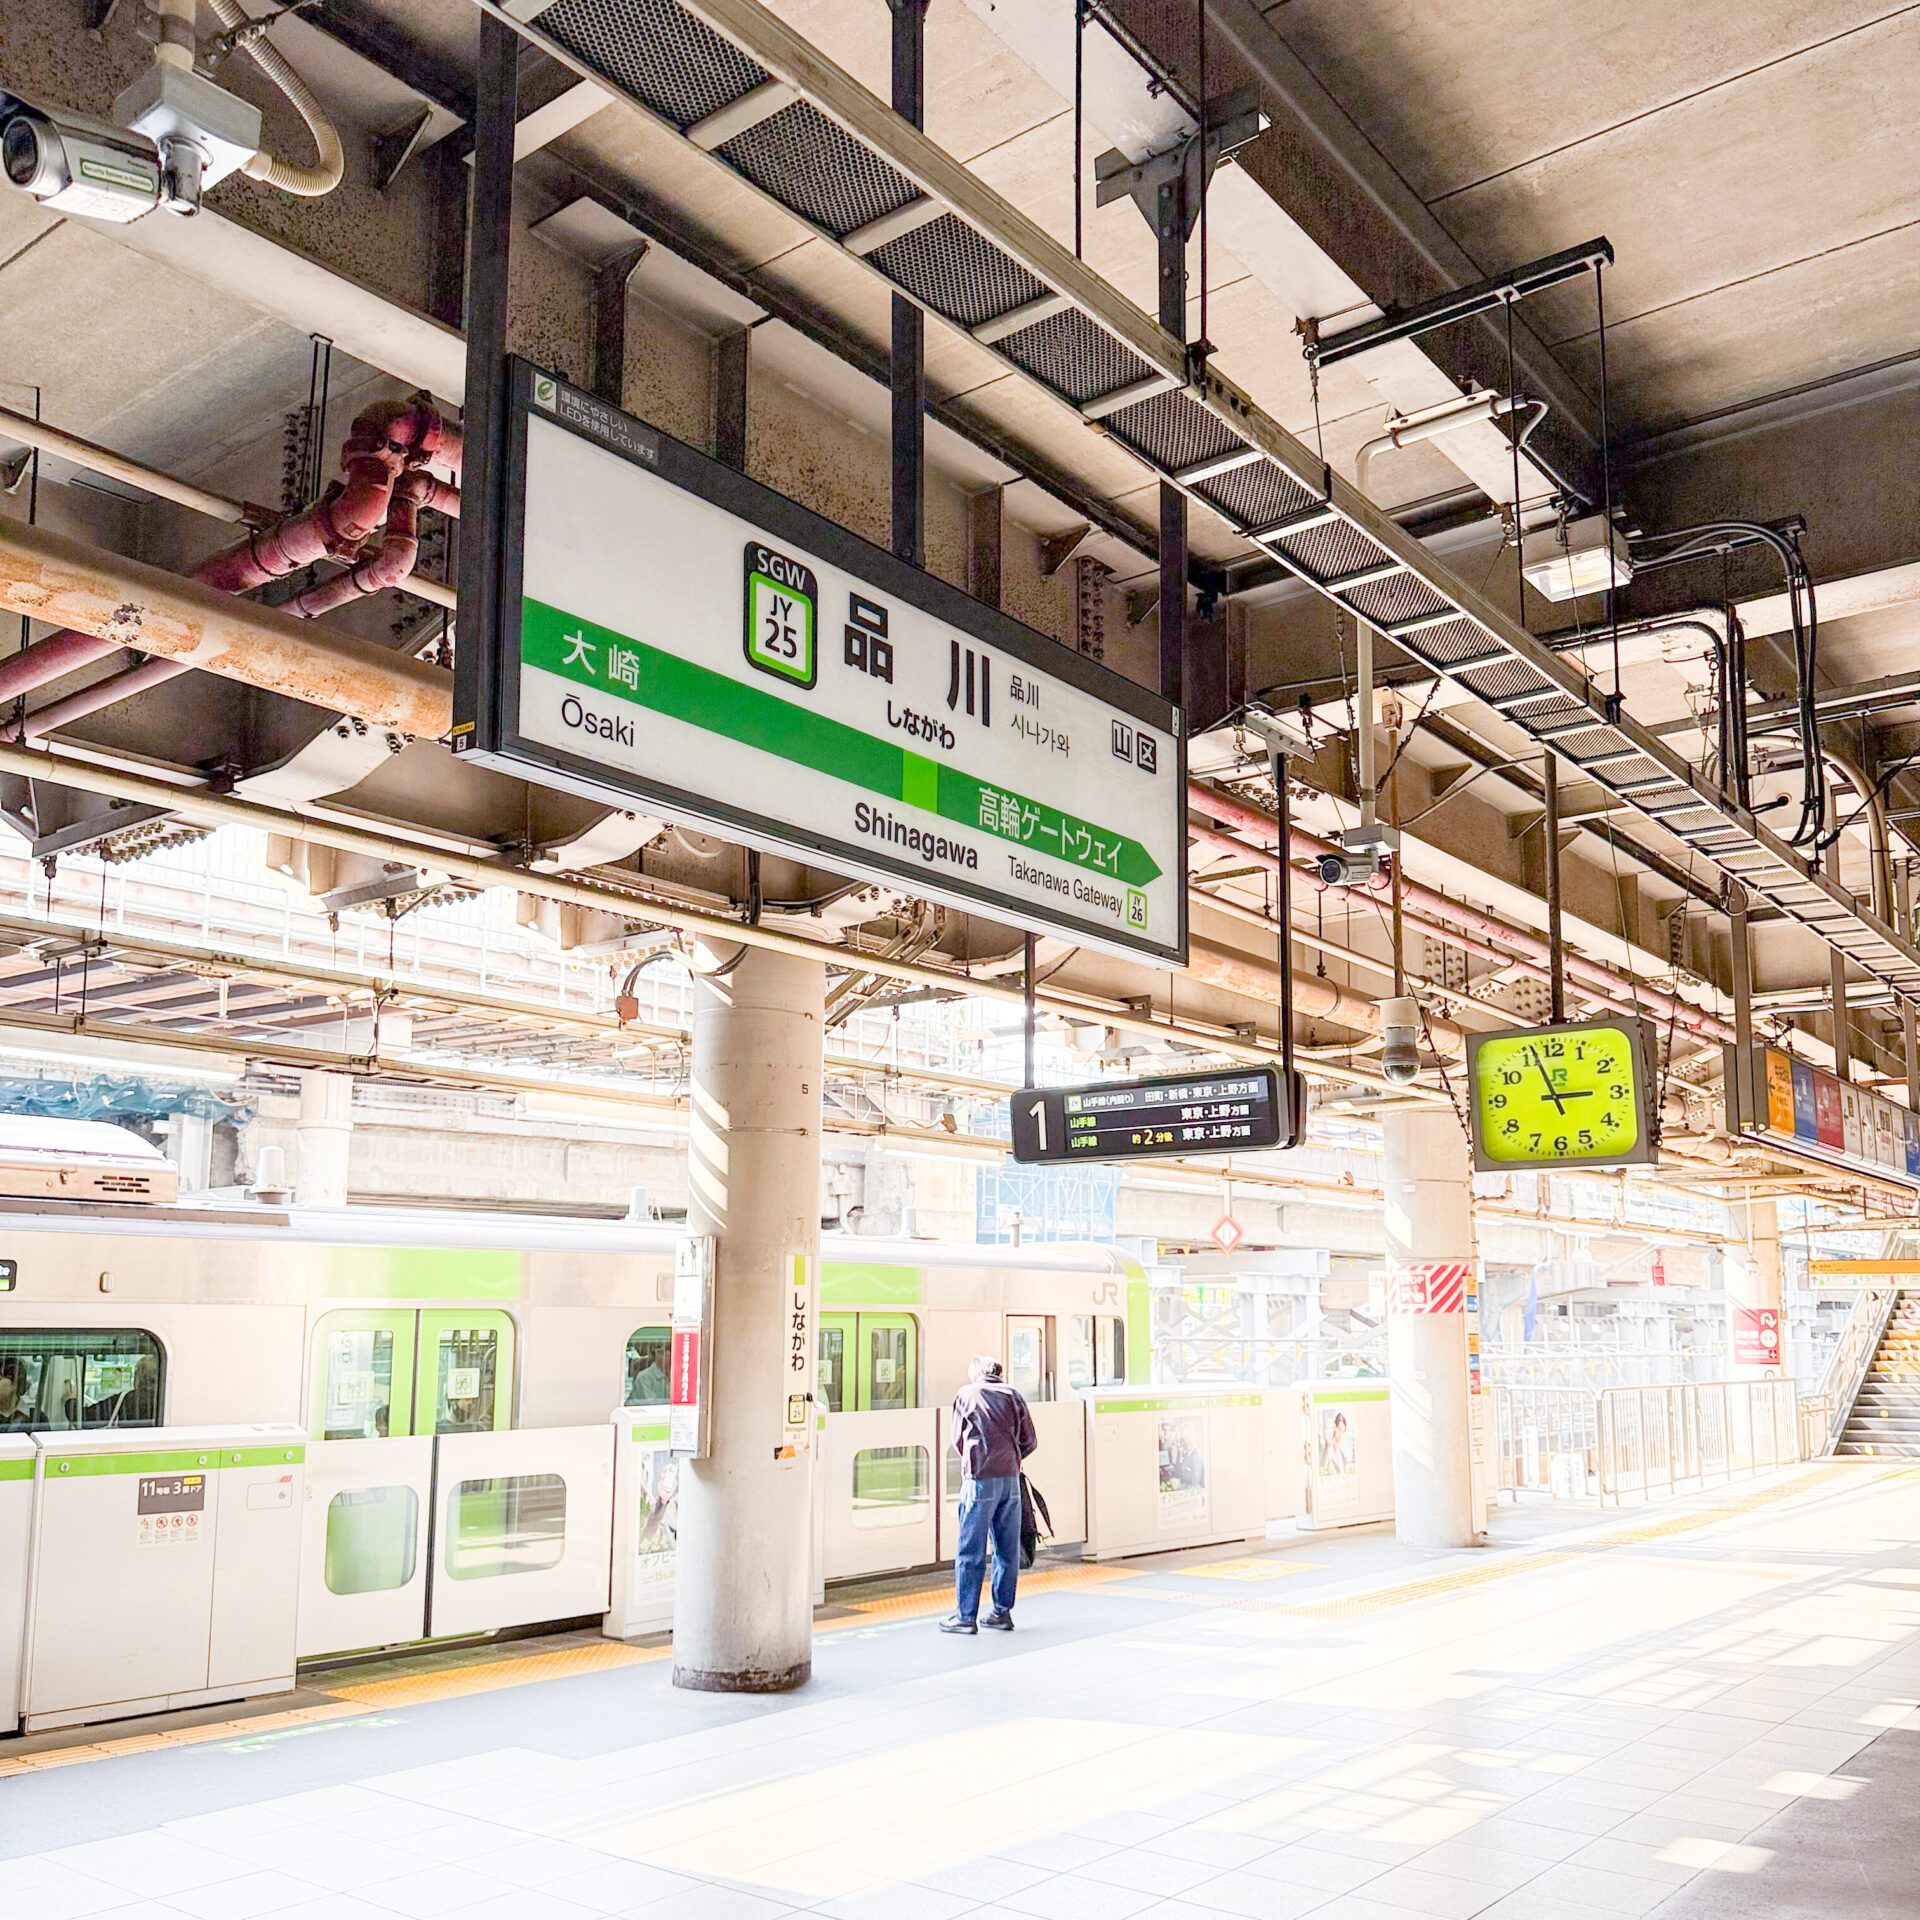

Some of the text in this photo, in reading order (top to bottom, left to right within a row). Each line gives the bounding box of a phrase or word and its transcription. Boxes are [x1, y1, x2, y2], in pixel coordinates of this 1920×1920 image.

[560, 403, 656, 460] LEDを使用しています
[757, 548, 806, 590] SGW
[770, 594, 792, 622] JY
[765, 617, 797, 658] 25
[562, 629, 640, 690] 大崎
[845, 591, 990, 728] 品川
[1010, 674, 1039, 710] 品川
[561, 693, 634, 747] Ōsaki
[887, 700, 955, 750] しながわ
[1010, 713, 1071, 759] 시나가와
[855, 802, 978, 870] Shinagawa
[979, 787, 1122, 874] 高輪ゲートウェイ
[1008, 854, 1123, 918] Takanawa Gateway
[1131, 906, 1143, 921] 26
[1543, 1043, 1565, 1058] 12
[1576, 1046, 1585, 1060] 1
[1596, 1059, 1611, 1074] 2
[1502, 1071, 1522, 1085] 10
[1551, 1068, 1568, 1081] JR
[801, 1083, 809, 1095] 5
[1609, 1085, 1624, 1099] 3
[1493, 1094, 1507, 1109] 9
[1028, 1100, 1048, 1150] 1
[1069, 1116, 1097, 1129] 山手線
[1506, 1118, 1520, 1133] 8
[1600, 1112, 1614, 1127] 4
[1070, 1135, 1099, 1149] 山手線
[1529, 1133, 1542, 1148] 7
[1554, 1136, 1568, 1150] 6
[1578, 1130, 1592, 1145] 5
[1092, 1281, 1119, 1306] JR
[791, 1292, 805, 1371] しながわ
[793, 1410, 802, 1419] 25
